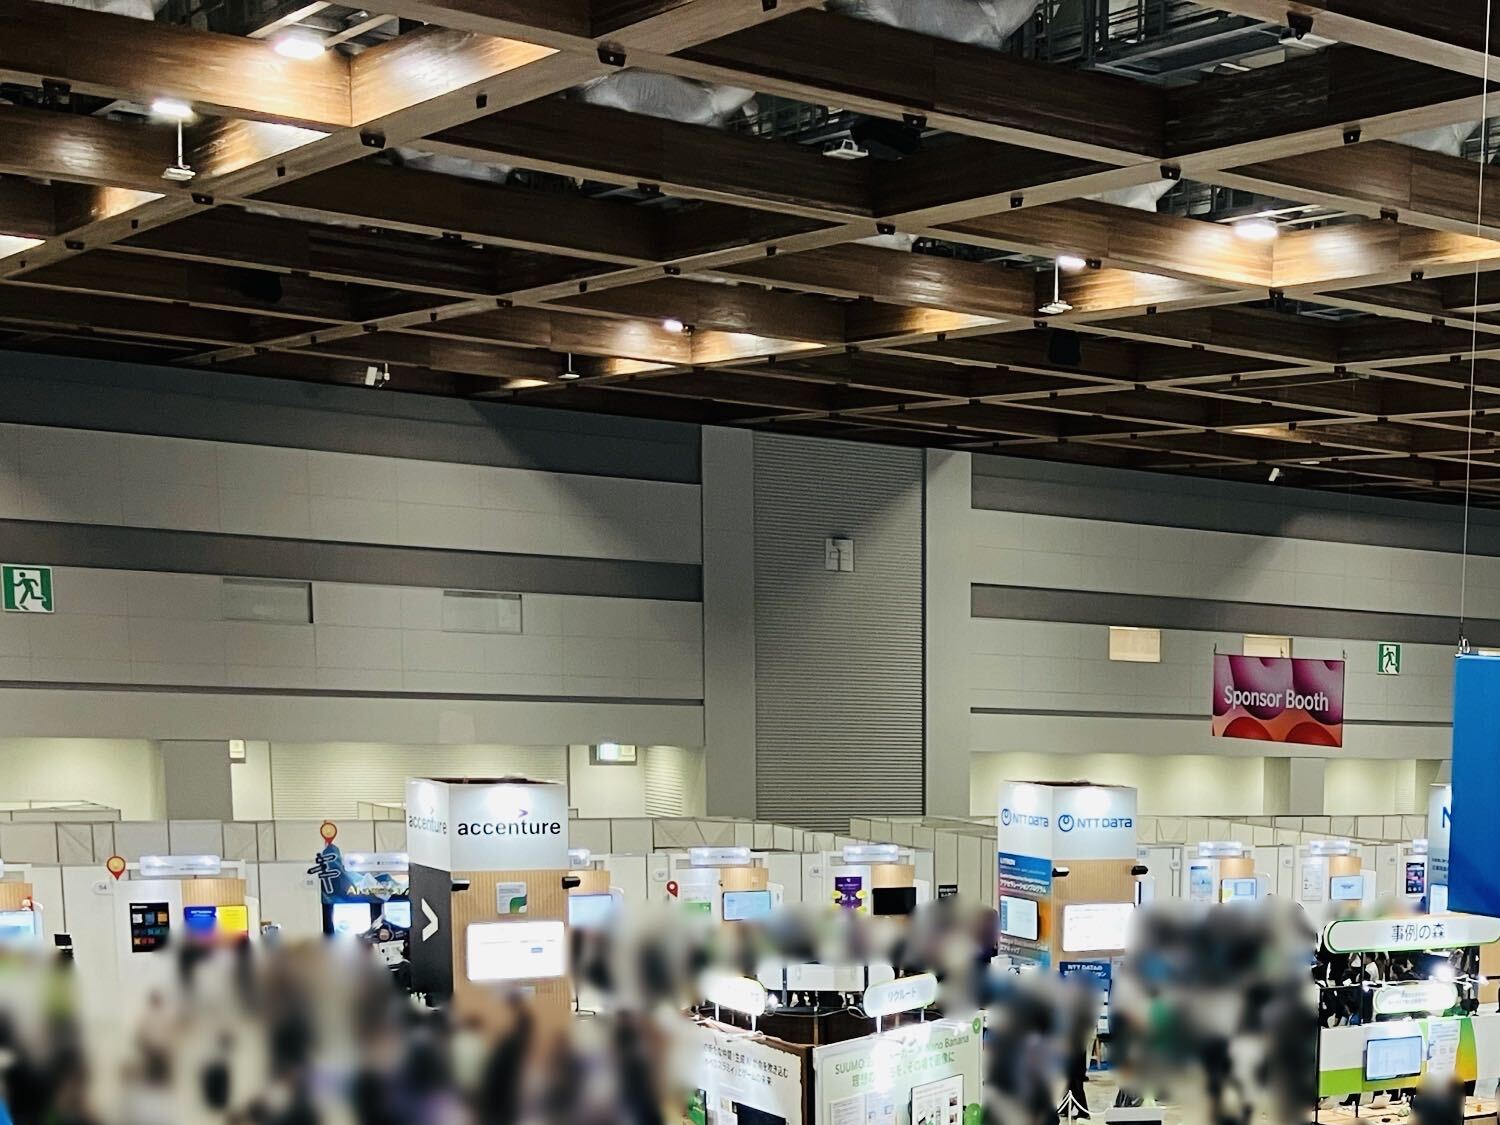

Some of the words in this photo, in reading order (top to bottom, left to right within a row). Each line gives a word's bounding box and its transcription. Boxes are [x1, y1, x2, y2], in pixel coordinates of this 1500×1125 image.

[1224, 685, 1282, 709] Sponsor
[1285, 689, 1329, 711] Booth
[408, 814, 447, 836] accenture
[457, 819, 562, 836] accenture
[1012, 813, 1027, 825] NTT
[1077, 818, 1099, 829] NTT
[1391, 923, 1445, 943] 事例の森
[835, 1058, 865, 1076] SUUMO
